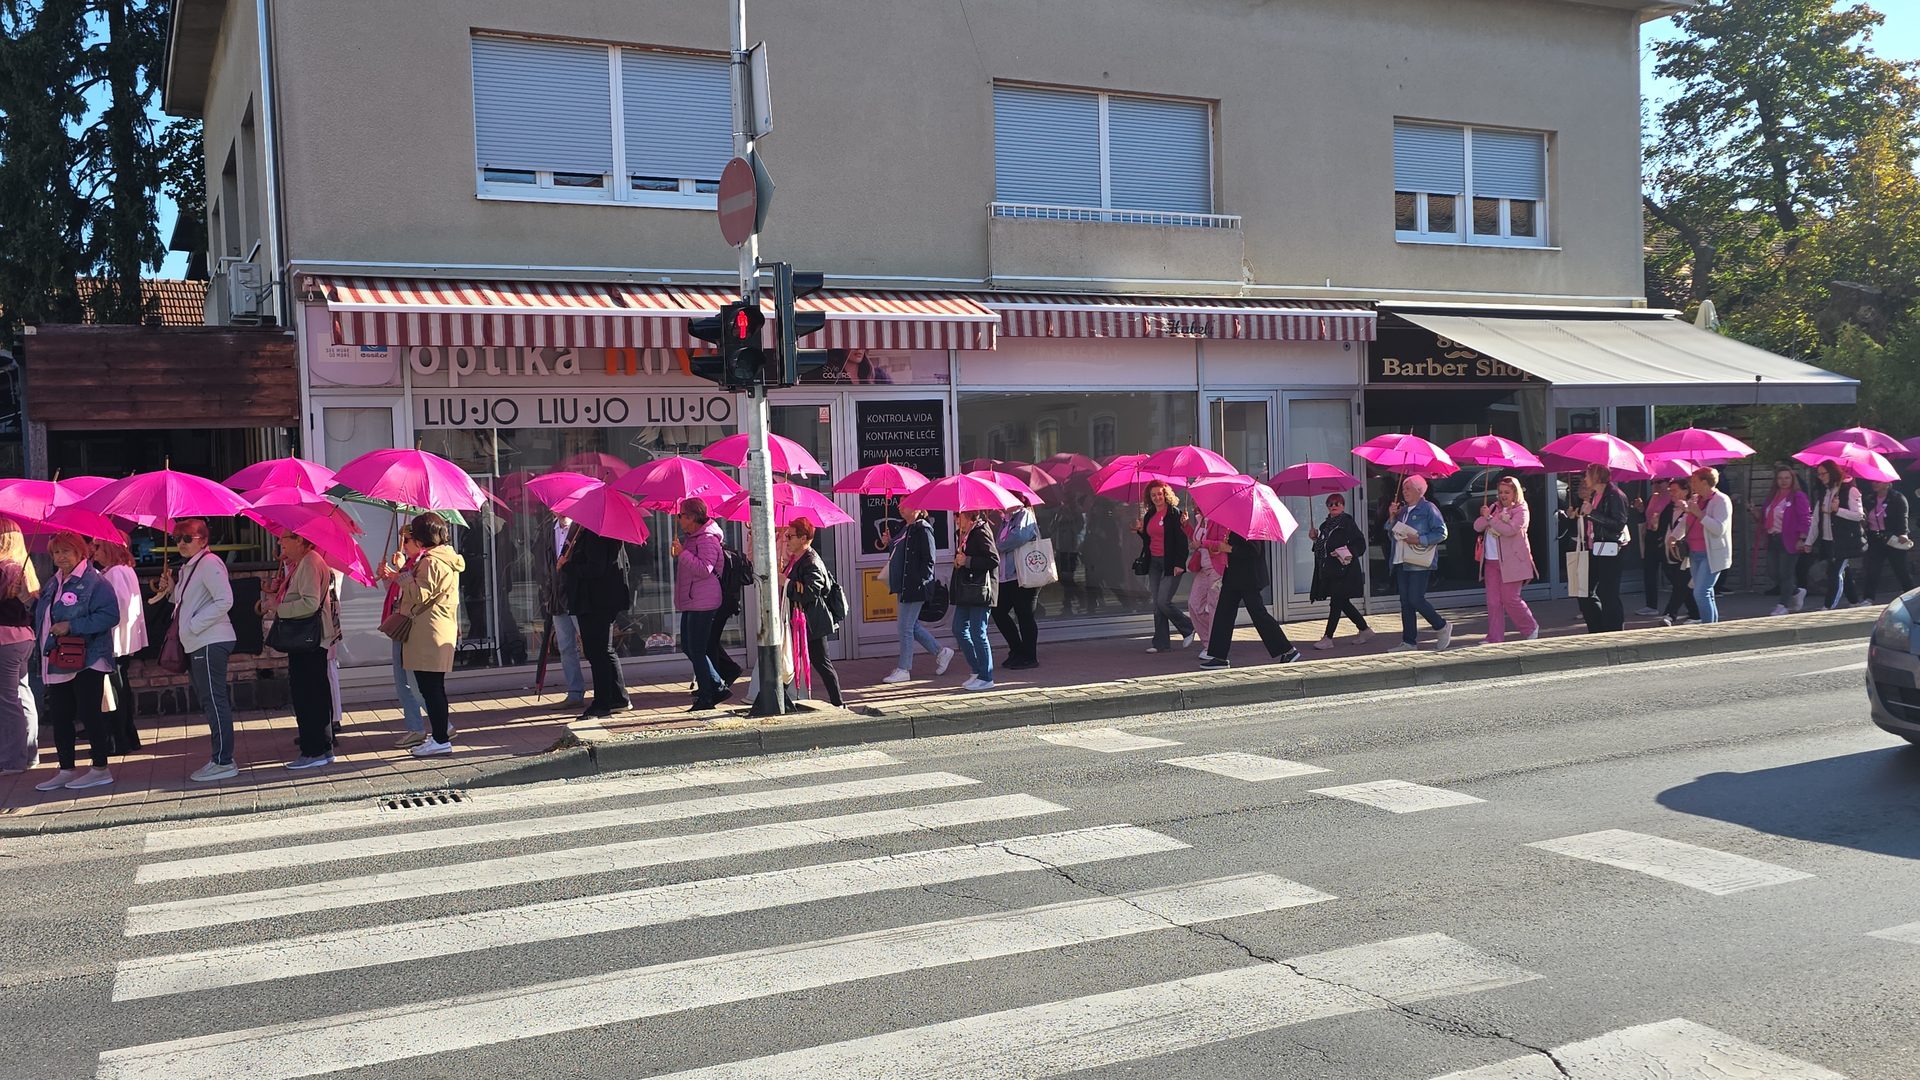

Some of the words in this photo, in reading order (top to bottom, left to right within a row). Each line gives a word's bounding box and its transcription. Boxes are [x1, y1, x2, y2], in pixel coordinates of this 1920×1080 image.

[410, 346, 581, 388] optika
[1382, 358, 1468, 376] Barber
[867, 413, 912, 423] KONTROLA
[913, 413, 933, 422] VIDA
[866, 431, 915, 441] KONTAKTNE
[863, 449, 904, 459] PRIMAMO
[905, 447, 940, 457] RECEPTE
[867, 497, 898, 507] IZRADA
